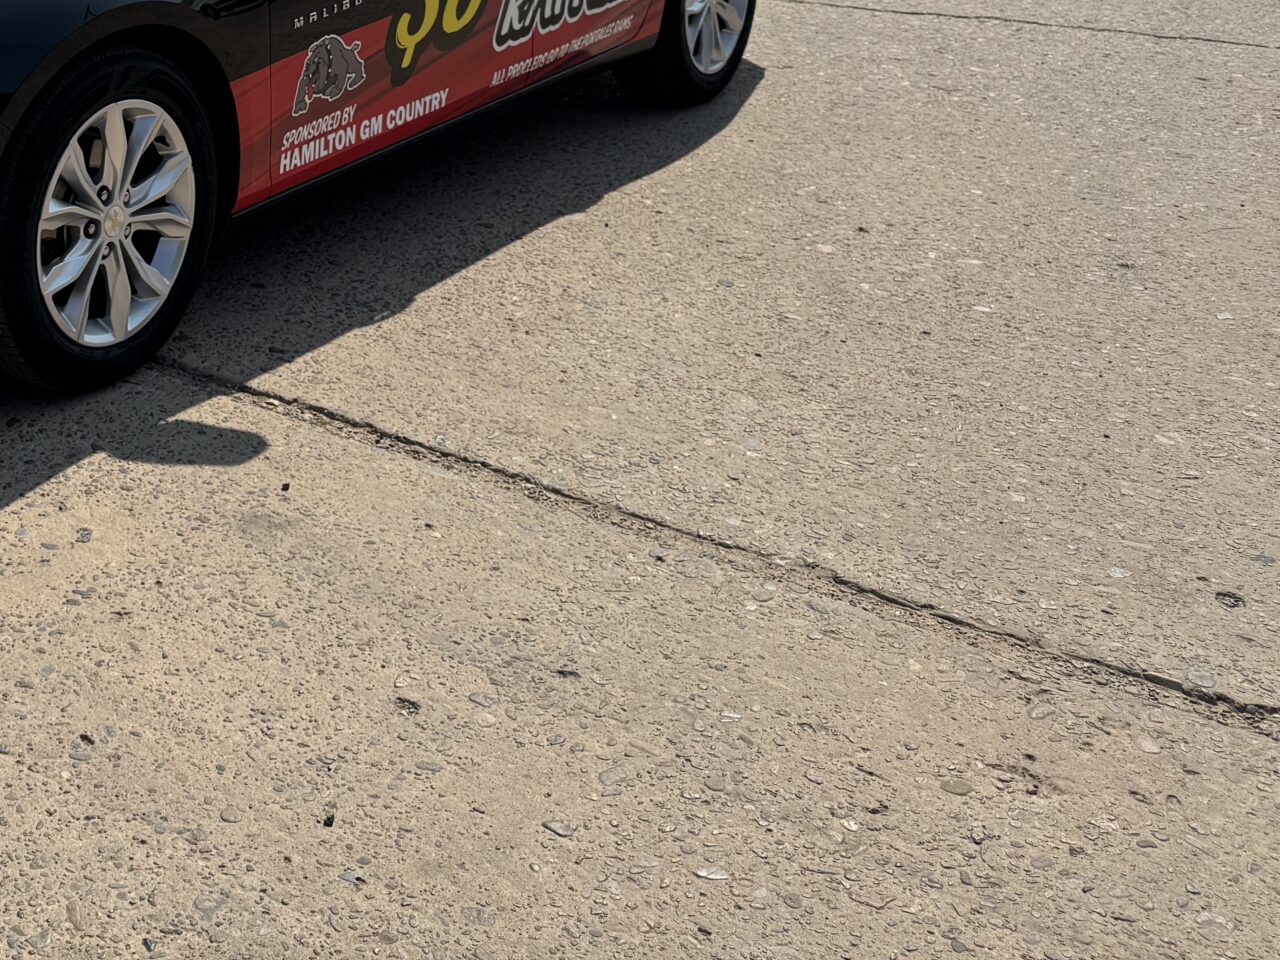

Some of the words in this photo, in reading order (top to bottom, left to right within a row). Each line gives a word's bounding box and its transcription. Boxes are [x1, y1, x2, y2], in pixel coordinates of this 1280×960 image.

[490, 68, 506, 88] ALL
[280, 125, 357, 174] HAMILTON
[360, 114, 383, 140] GM
[386, 88, 449, 130] COUNTRY
[281, 110, 341, 151] SPONSORED
[341, 104, 357, 126] BY
